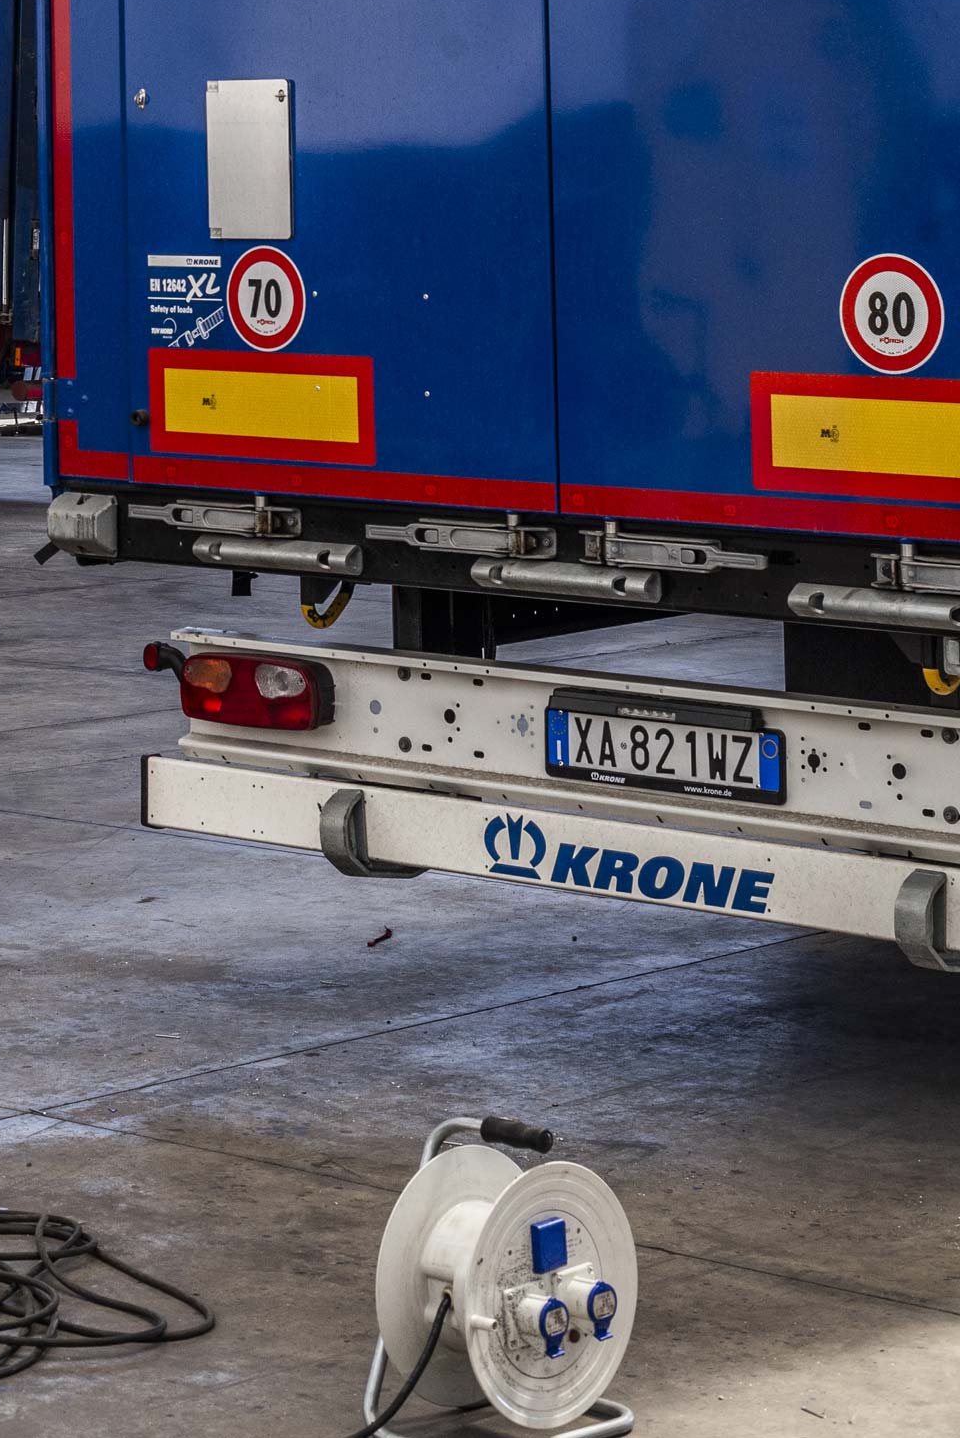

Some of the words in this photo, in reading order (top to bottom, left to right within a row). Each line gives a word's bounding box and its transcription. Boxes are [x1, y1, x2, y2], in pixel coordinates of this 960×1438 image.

[150, 278, 161, 292] EN
[162, 278, 187, 293] 12642
[185, 272, 221, 303] XL
[248, 278, 282, 319] 70
[150, 304, 169, 315] Safety
[170, 305, 177, 313] of
[177, 305, 193, 314] loads
[868, 291, 916, 337] 80
[598, 774, 626, 784] KRONE
[684, 785, 732, 797] www.krone.de
[550, 843, 775, 914] KRONE
